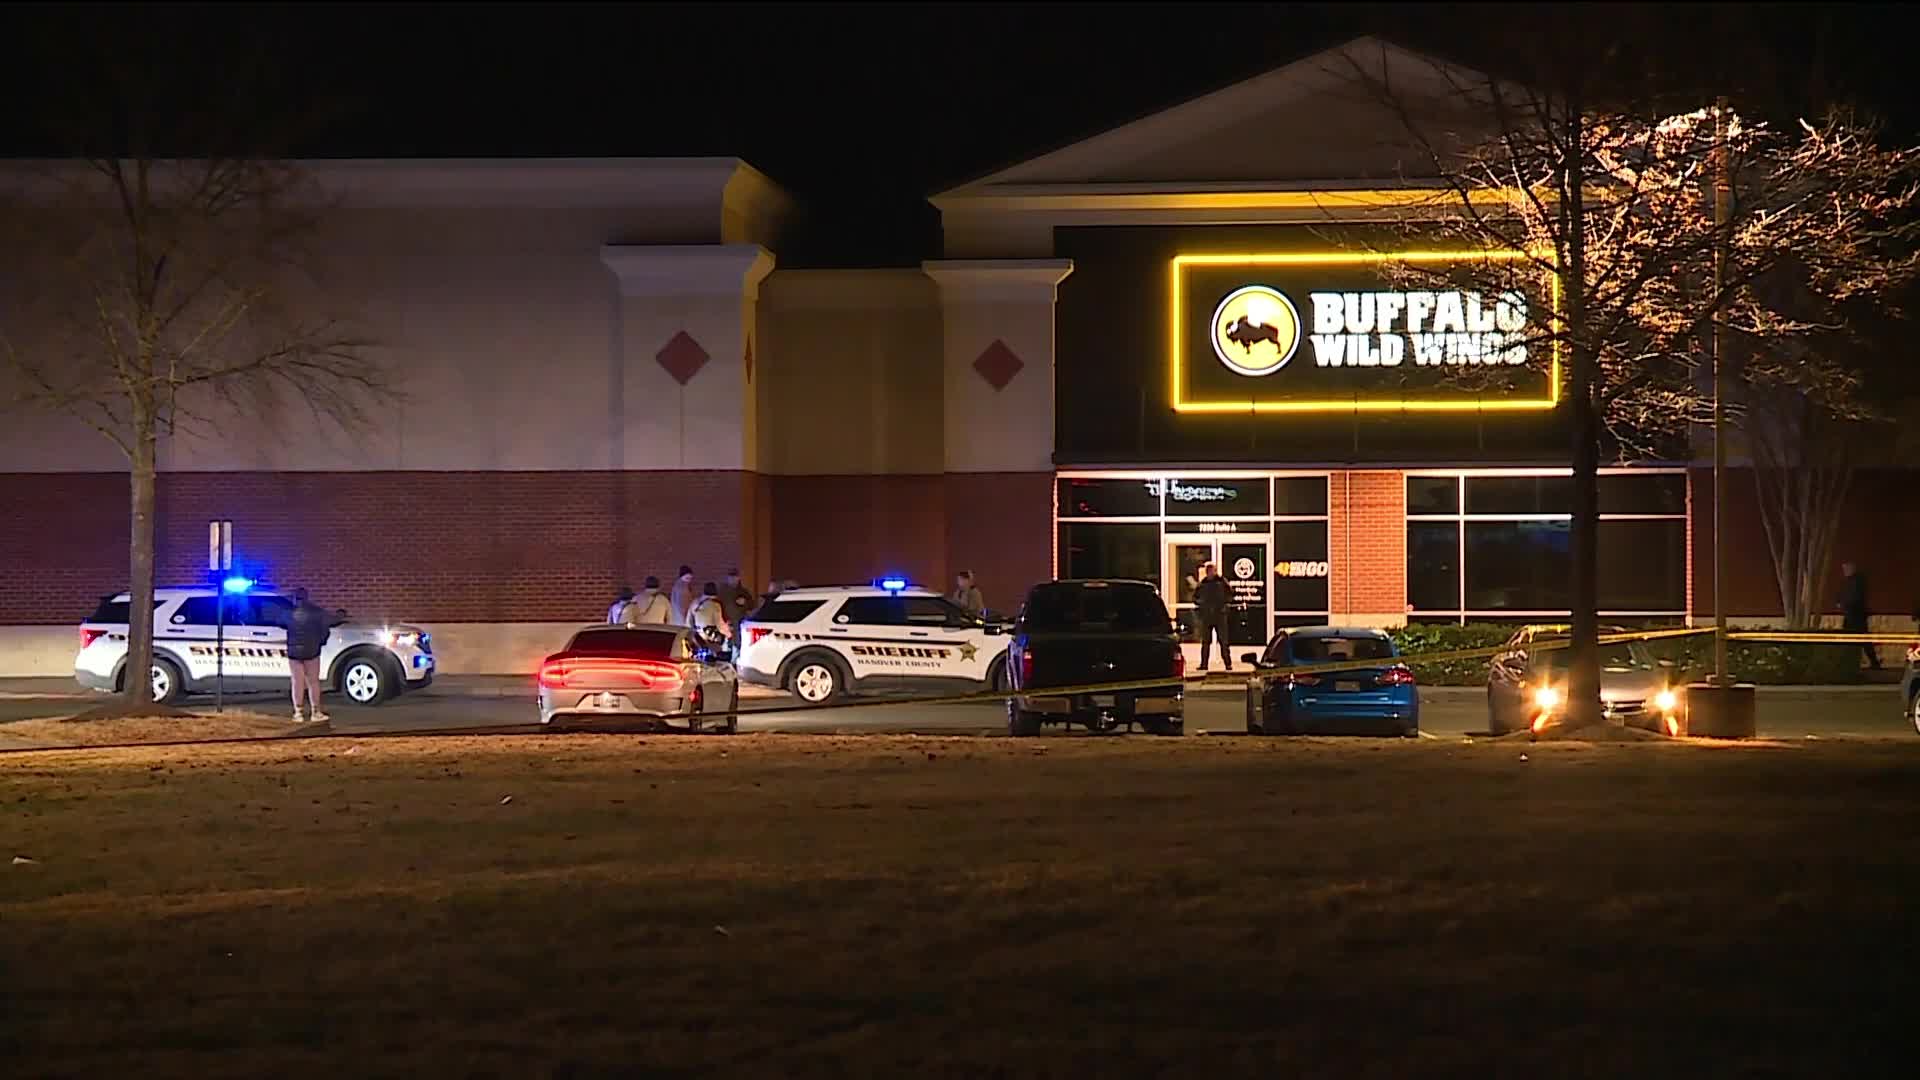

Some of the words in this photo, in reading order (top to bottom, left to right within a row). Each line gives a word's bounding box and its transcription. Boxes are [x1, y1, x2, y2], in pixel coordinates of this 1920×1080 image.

[1309, 290, 1528, 333] BUFFALO
[1308, 332, 1404, 367] WILD
[1405, 332, 1528, 366] WINGS
[851, 645, 952, 659] SHERIFF
[856, 659, 903, 667] HANOVER
[904, 660, 942, 668] COUNTY
